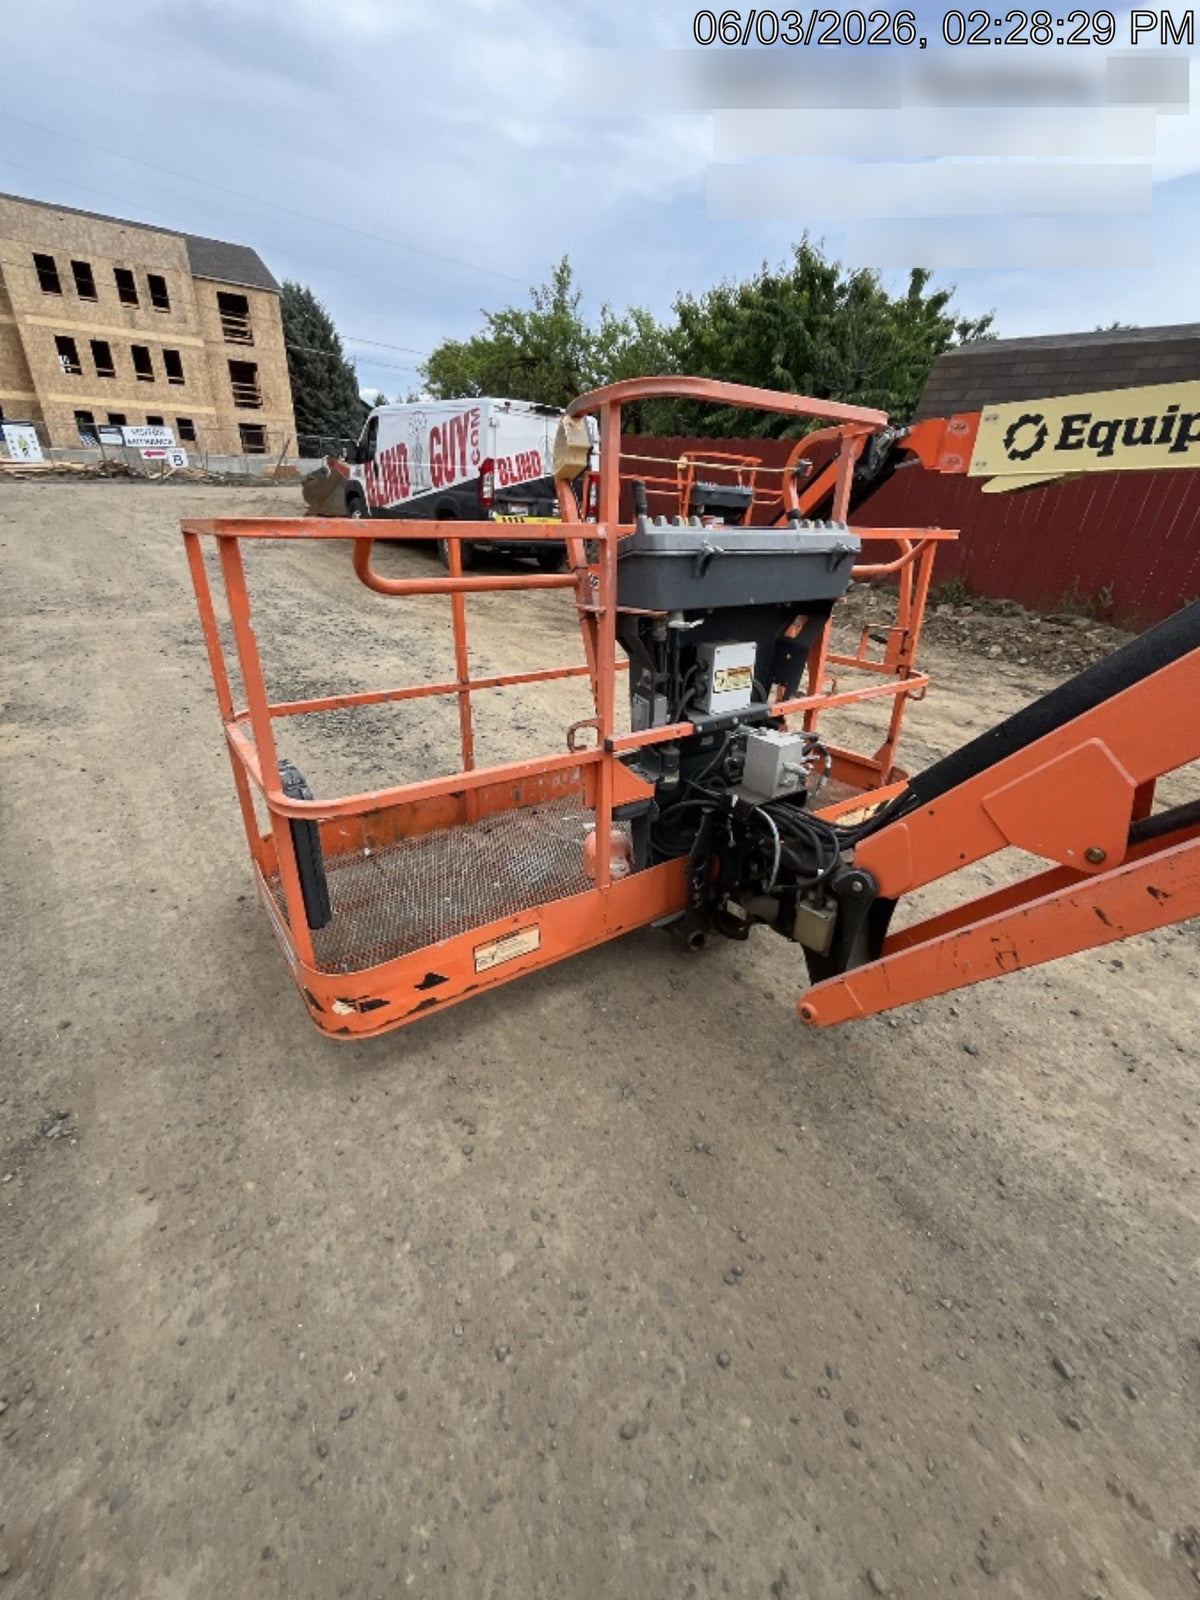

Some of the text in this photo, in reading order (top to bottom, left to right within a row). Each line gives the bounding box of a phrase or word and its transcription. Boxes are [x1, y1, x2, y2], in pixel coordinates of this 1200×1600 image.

[172, 455, 184, 466] B
[365, 411, 470, 506] BLIND GUY
[497, 450, 541, 486] BLIND
